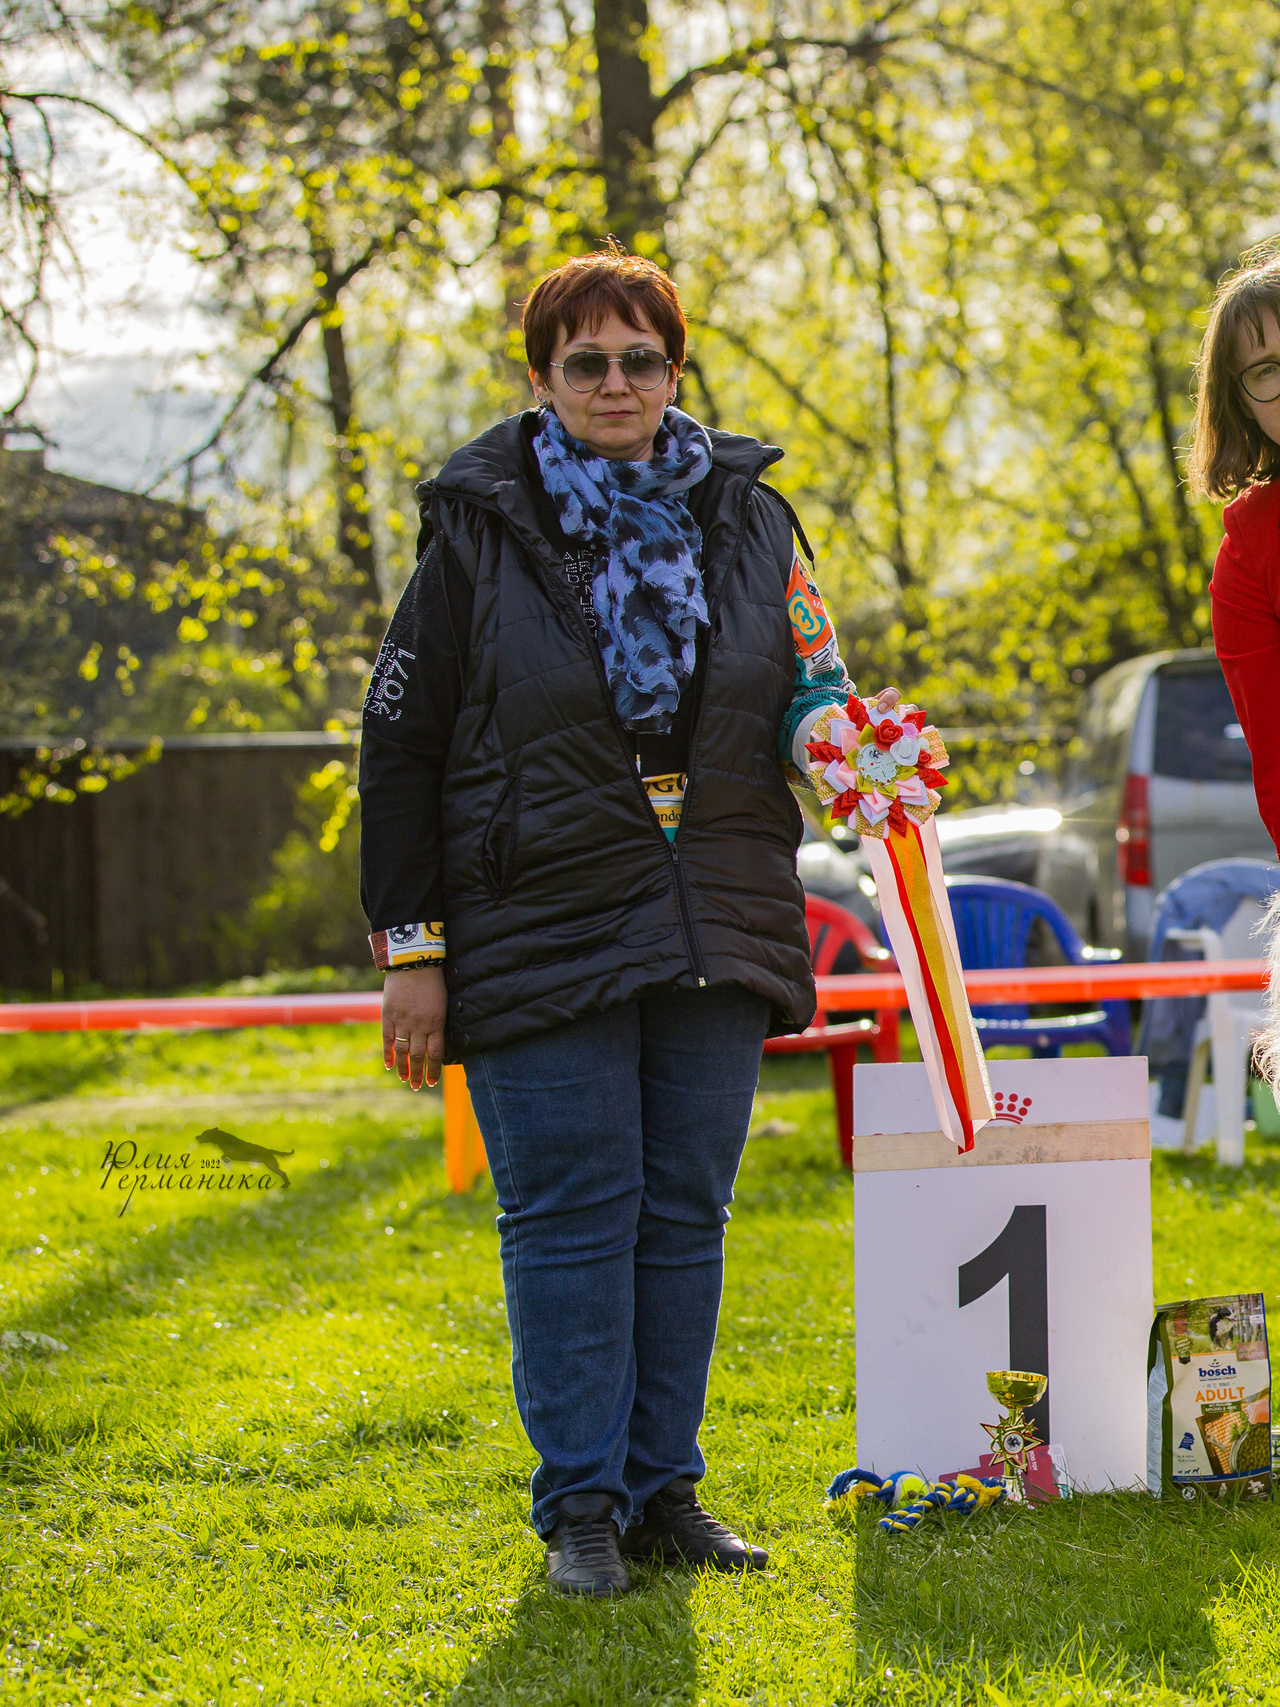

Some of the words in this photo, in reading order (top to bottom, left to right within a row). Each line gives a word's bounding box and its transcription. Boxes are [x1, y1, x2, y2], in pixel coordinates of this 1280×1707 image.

[958, 1204, 1050, 1446] 1
[1198, 1365, 1237, 1377] bosch
[1195, 1386, 1245, 1403] ADULT
